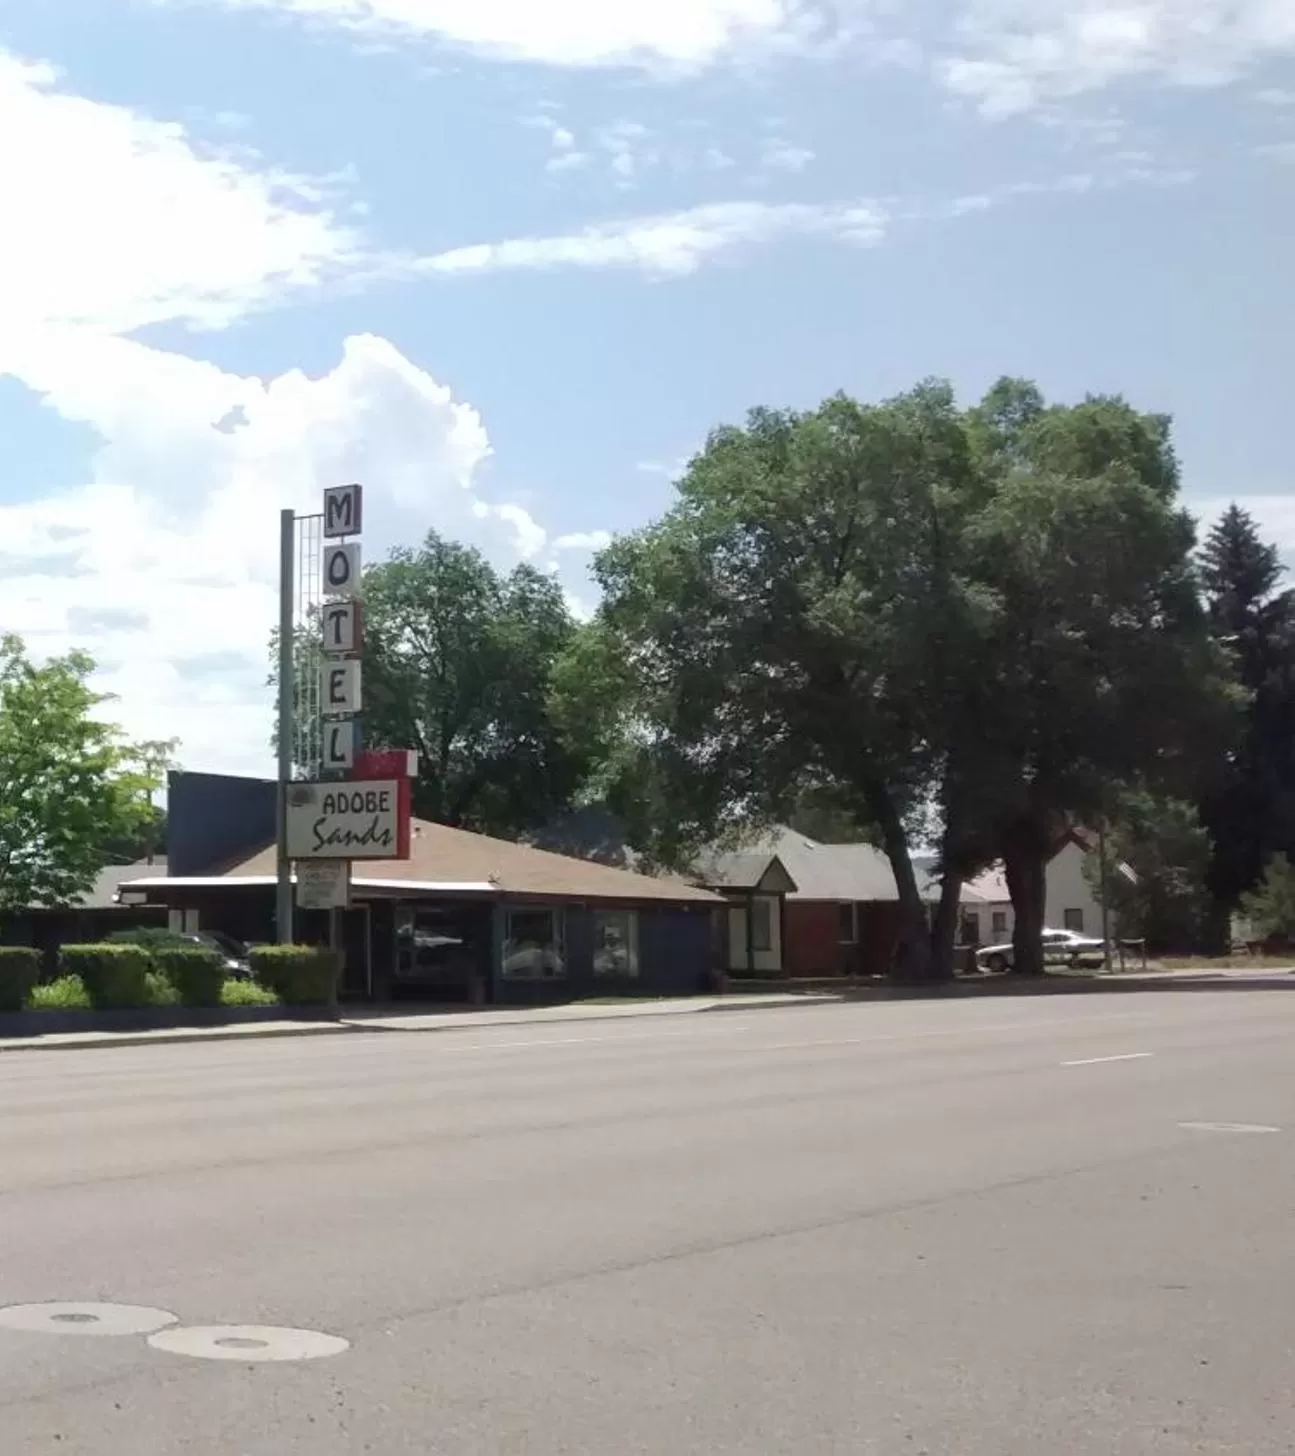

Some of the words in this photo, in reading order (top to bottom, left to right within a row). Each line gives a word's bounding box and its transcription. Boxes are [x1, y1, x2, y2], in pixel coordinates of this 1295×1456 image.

[328, 493, 352, 763] MOTEL
[322, 791, 390, 814] ADOBE
[312, 815, 393, 852] Sands
